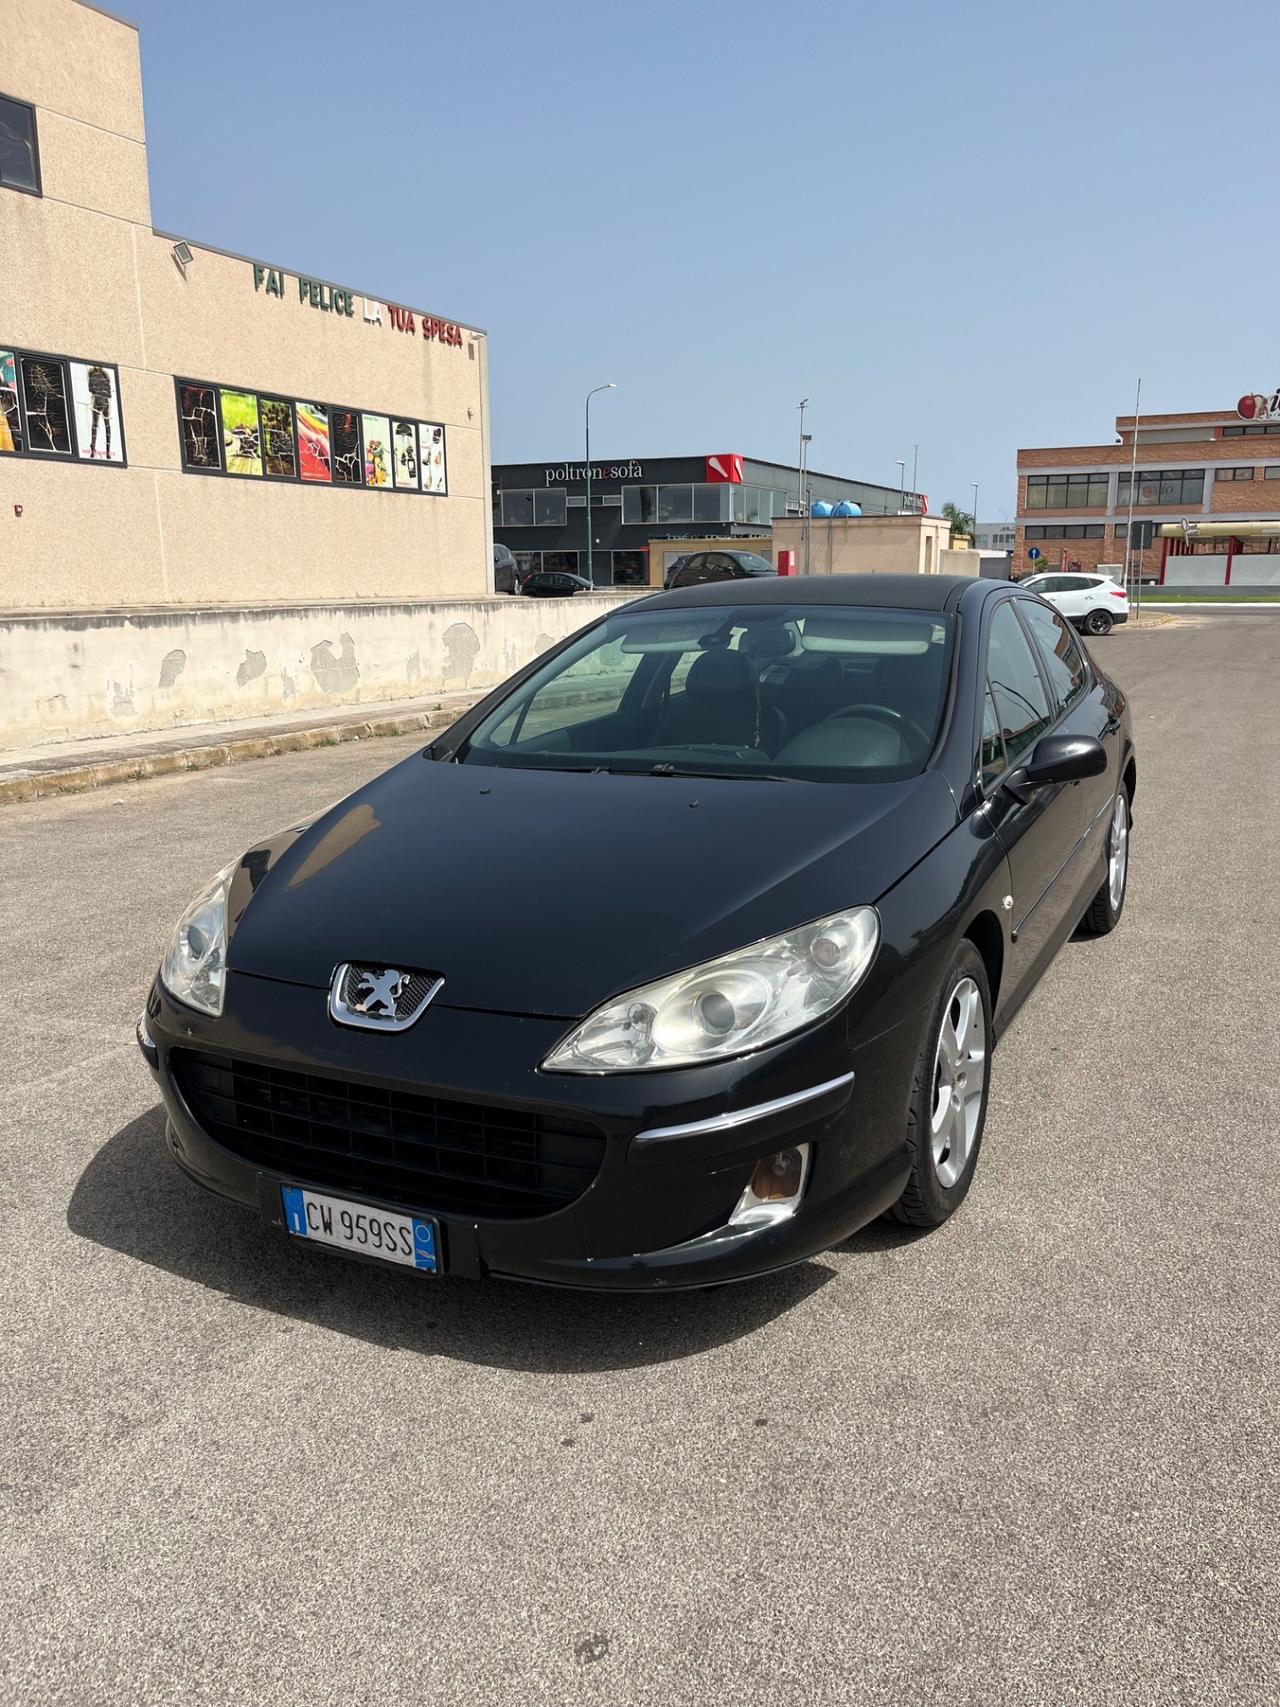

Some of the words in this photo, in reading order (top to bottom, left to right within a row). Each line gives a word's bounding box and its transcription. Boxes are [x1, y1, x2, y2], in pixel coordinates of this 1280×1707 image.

[253, 263, 285, 298] FAI
[299, 277, 354, 317] FELICE
[363, 298, 382, 326] LA
[388, 305, 416, 335] TUA
[422, 316, 463, 348] SPESA
[545, 459, 643, 487] poltronesofà
[306, 1202, 333, 1236] CW
[340, 1210, 413, 1256] 959SS
